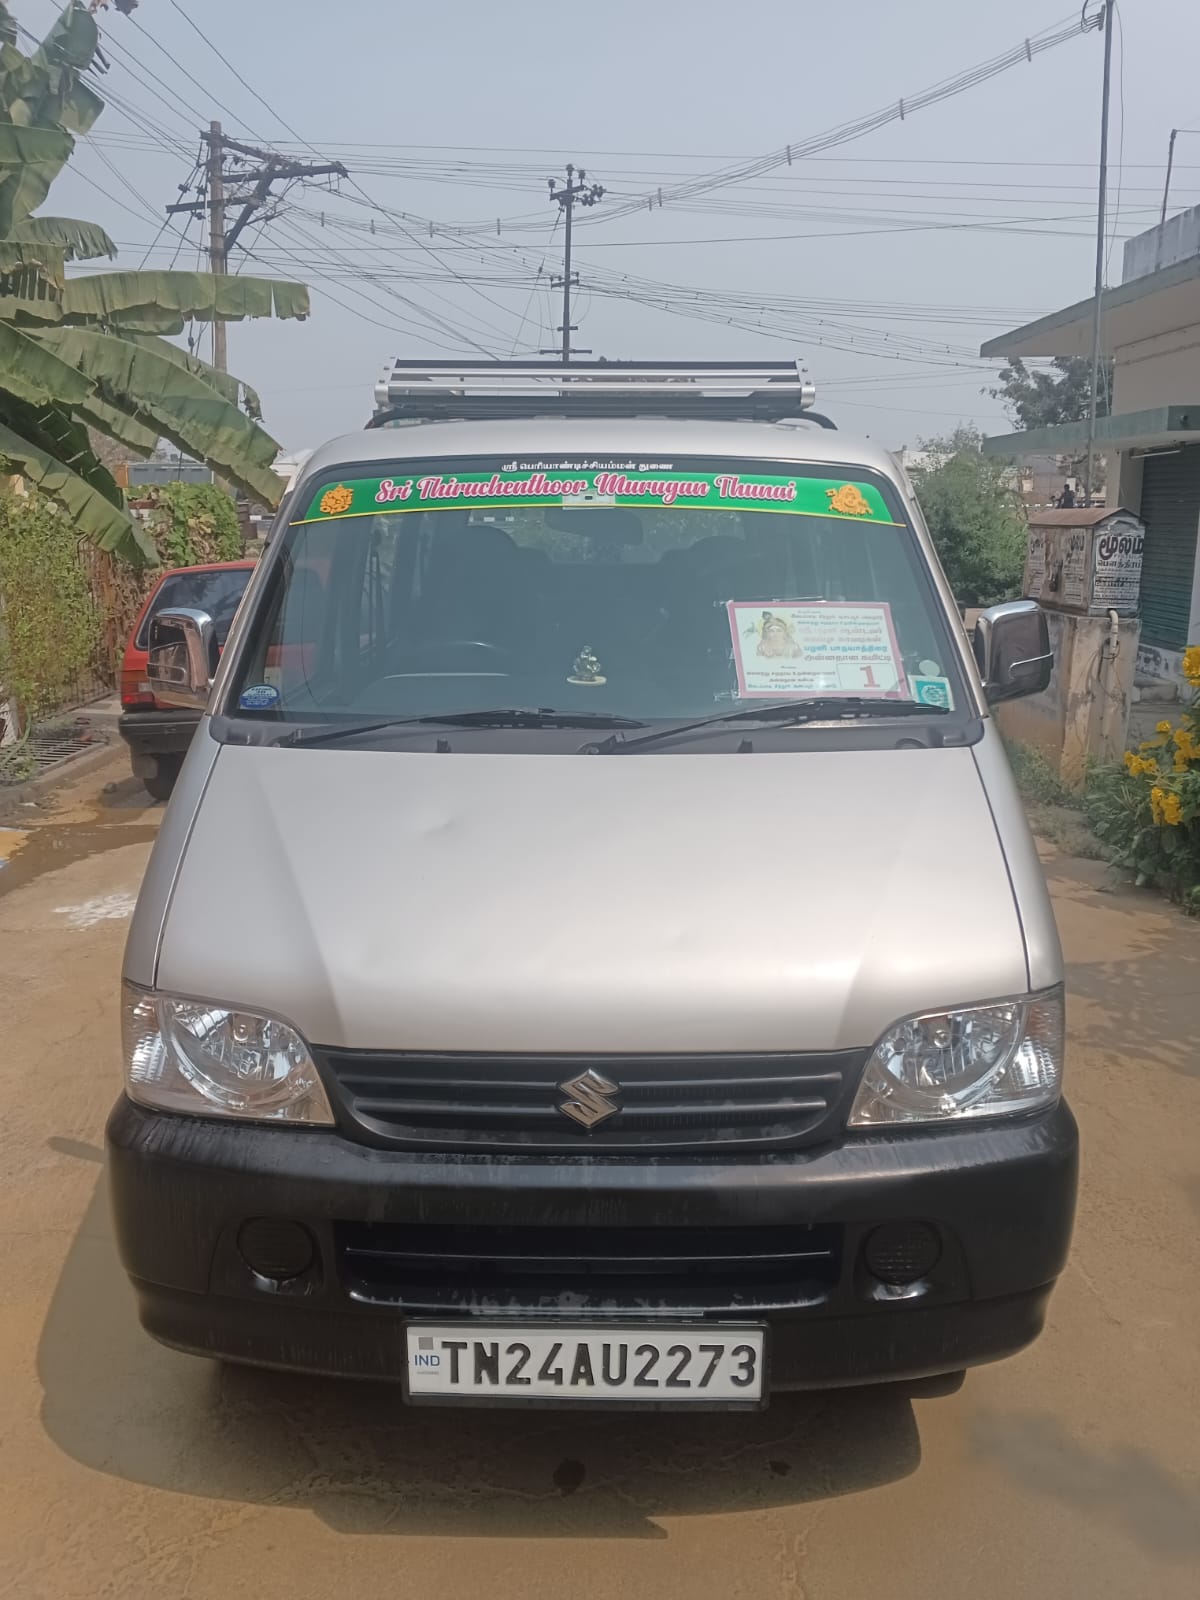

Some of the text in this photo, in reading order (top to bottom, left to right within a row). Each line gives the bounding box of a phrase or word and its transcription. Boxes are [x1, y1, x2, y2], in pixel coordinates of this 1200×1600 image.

[639, 463, 673, 472] துணை
[375, 472, 796, 505] Sri Thiruchenthoor Murugan Thunai
[860, 665, 880, 688] 1
[414, 1341, 757, 1389] IND TN24AU2273
